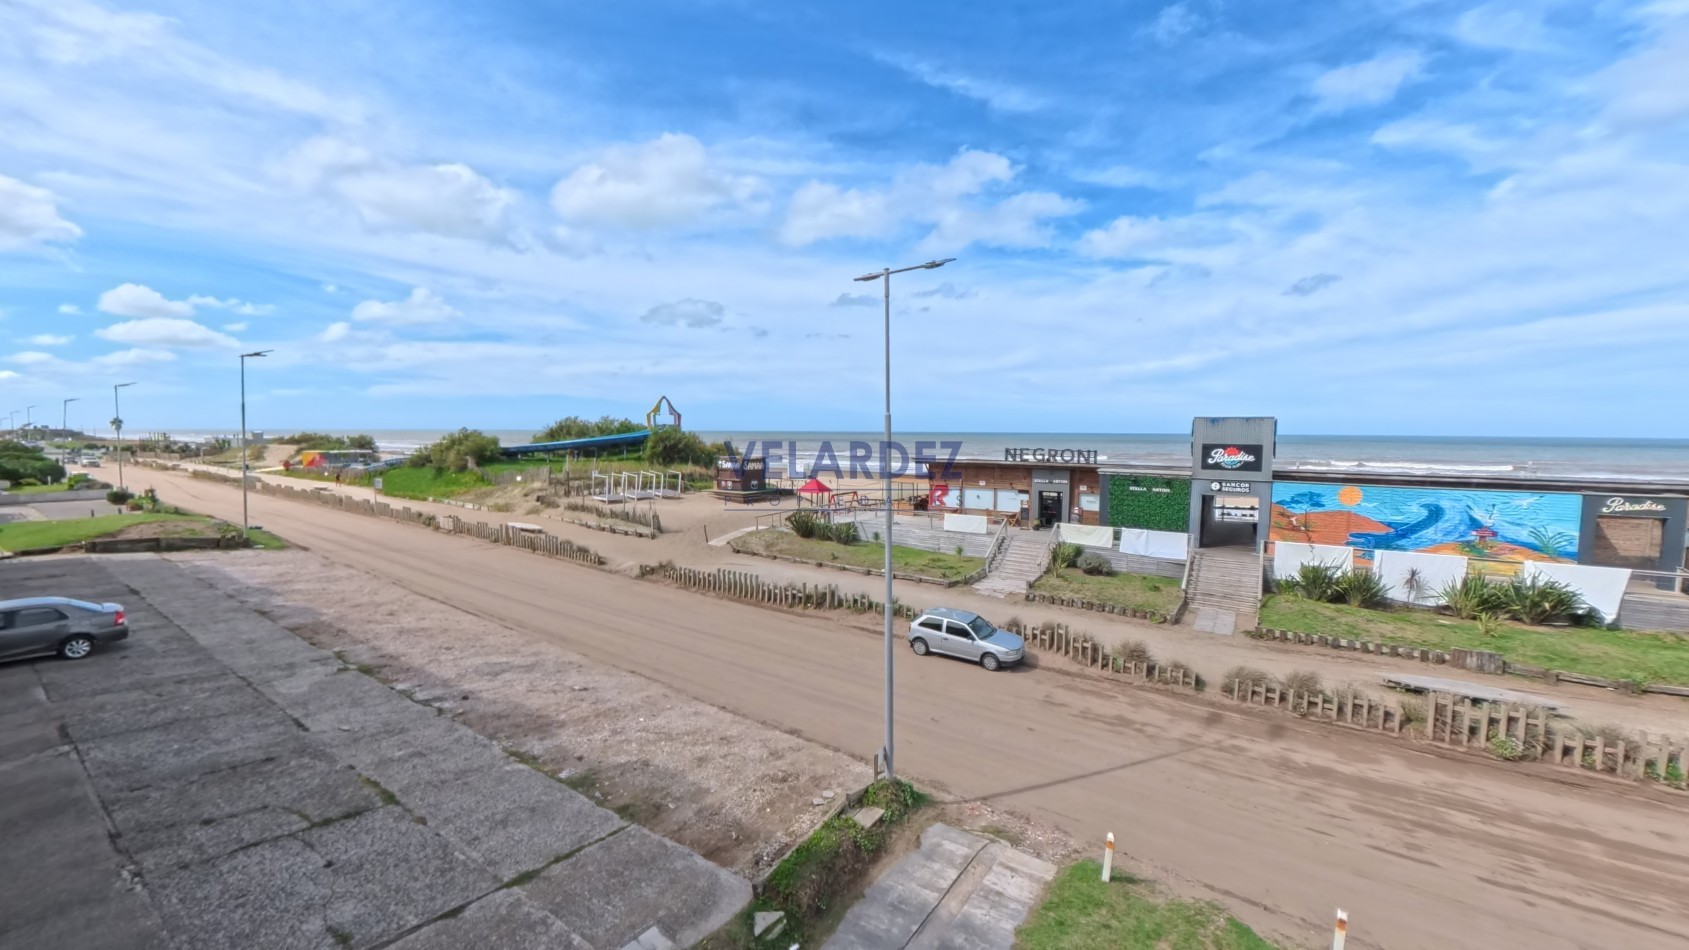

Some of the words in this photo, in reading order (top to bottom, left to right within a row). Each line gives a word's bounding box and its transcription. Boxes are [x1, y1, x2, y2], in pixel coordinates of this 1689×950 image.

[1004, 447, 1098, 464] NEGRONI
[1207, 448, 1256, 464] Paradise
[1602, 497, 1667, 513] Paradise
